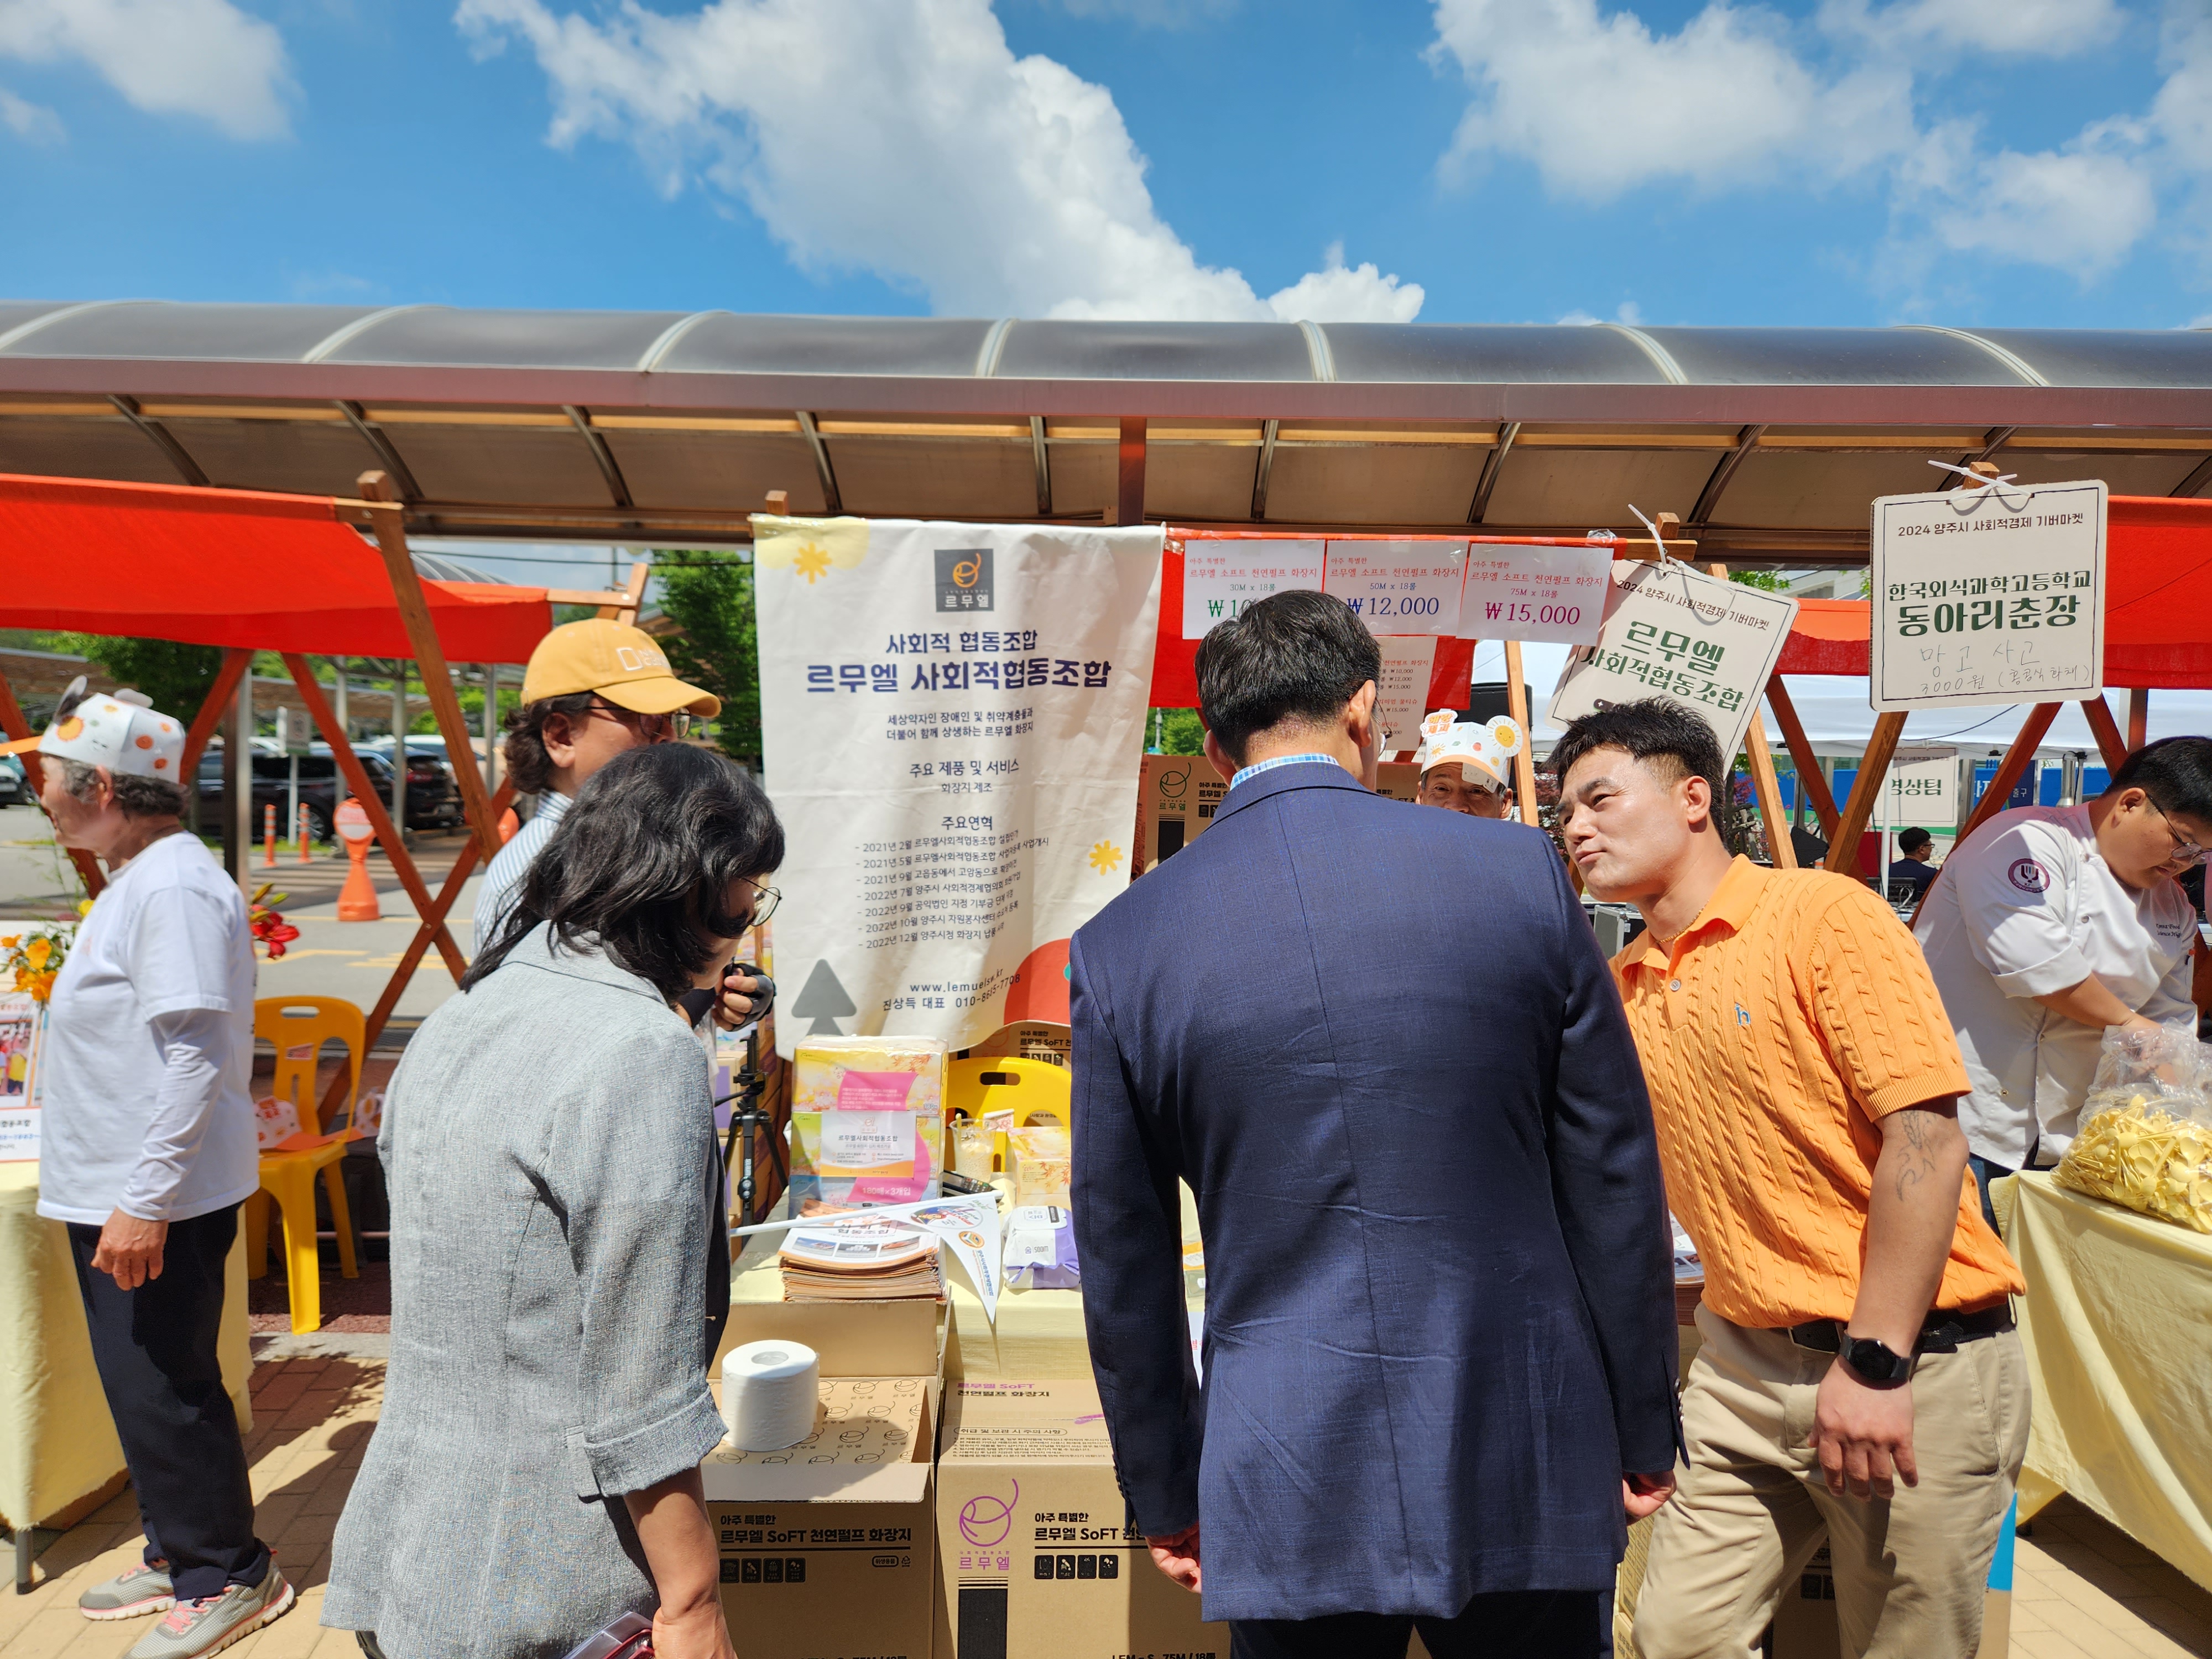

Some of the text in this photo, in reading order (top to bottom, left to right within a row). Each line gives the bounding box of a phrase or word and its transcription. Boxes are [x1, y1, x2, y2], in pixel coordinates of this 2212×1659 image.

[1898, 513, 2084, 537] 2024 양주시 사회적경제 기버마켓
[1190, 569, 1215, 578] 르무엘
[1251, 568, 1286, 578] 천연펄프
[1291, 568, 1317, 578] 화장지
[1330, 568, 1356, 578] 르무엘
[1392, 568, 1428, 577] 천연펄프
[1432, 568, 1459, 578] 화장지
[1470, 572, 1498, 581] 르무엘
[1535, 575, 1571, 585] 천연펄프
[1575, 577, 1603, 587] 화장지
[1541, 590, 1558, 598] 18롤
[1888, 570, 2091, 602] 한국외식과학고등학교
[945, 594, 989, 608] 르무엘
[1616, 580, 1770, 631] 2024 양주시 사회적경제 기버마켓
[1485, 602, 1580, 625] ₩15,000
[1897, 595, 2080, 637] 동아리춘장
[886, 630, 1038, 654] 사회적 협동조합
[1620, 620, 1725, 676] 르무엘
[807, 658, 1112, 693] 르무엘 사회적협동조합
[1580, 646, 1745, 712] 사회적협동조합
[1920, 674, 1985, 696] 3000원
[888, 707, 1033, 726] 세상약자인 장애인 및 취약계층들과
[887, 721, 1034, 740] 더불어 함께 상생하는 르무엘 화장지
[910, 759, 1019, 778] 주요 제품 및 서비스
[941, 782, 993, 794] 화장지 제조
[1159, 802, 1186, 811] 르무엘
[941, 815, 993, 831] 주요연혁
[863, 842, 896, 852] 2021년
[899, 840, 912, 850] 2월
[914, 836, 996, 847] 르무엘사회적협동조합
[863, 858, 896, 868] 2021년
[899, 856, 912, 866] 5월
[914, 852, 996, 863] 르무엘사회적협동조합
[1022, 837, 1049, 851] 사업개시
[864, 874, 896, 884] 2021년
[899, 872, 912, 882] 9월
[915, 868, 956, 879] 고읍동에서
[959, 867, 998, 878] 고암동으로
[864, 880, 1003, 901] 2022년 7월 양주시 사회적경제협의회
[865, 905, 898, 917] 2022년
[900, 902, 912, 914] 9월
[915, 899, 948, 910] 공익법인
[951, 899, 968, 909] 지정
[970, 898, 993, 908] 기부금
[865, 921, 897, 933] 2022년
[900, 917, 919, 928] 10월
[921, 915, 946, 925] 양주시
[948, 914, 995, 925] 자원봉사센터
[866, 928, 997, 948] 2022년 12월 양주시청 화장지 납품
[883, 997, 945, 1011] 진상득 대표
[721, 1515, 776, 1525] 아주 특별한
[1035, 1512, 1089, 1523] 아주 특별한
[721, 1527, 911, 1543] 르무엘 SoFT 천연펄프 화장지
[1034, 1527, 1119, 1541] 르무엘 SoFT
[958, 1557, 1010, 1571] 르무엘
